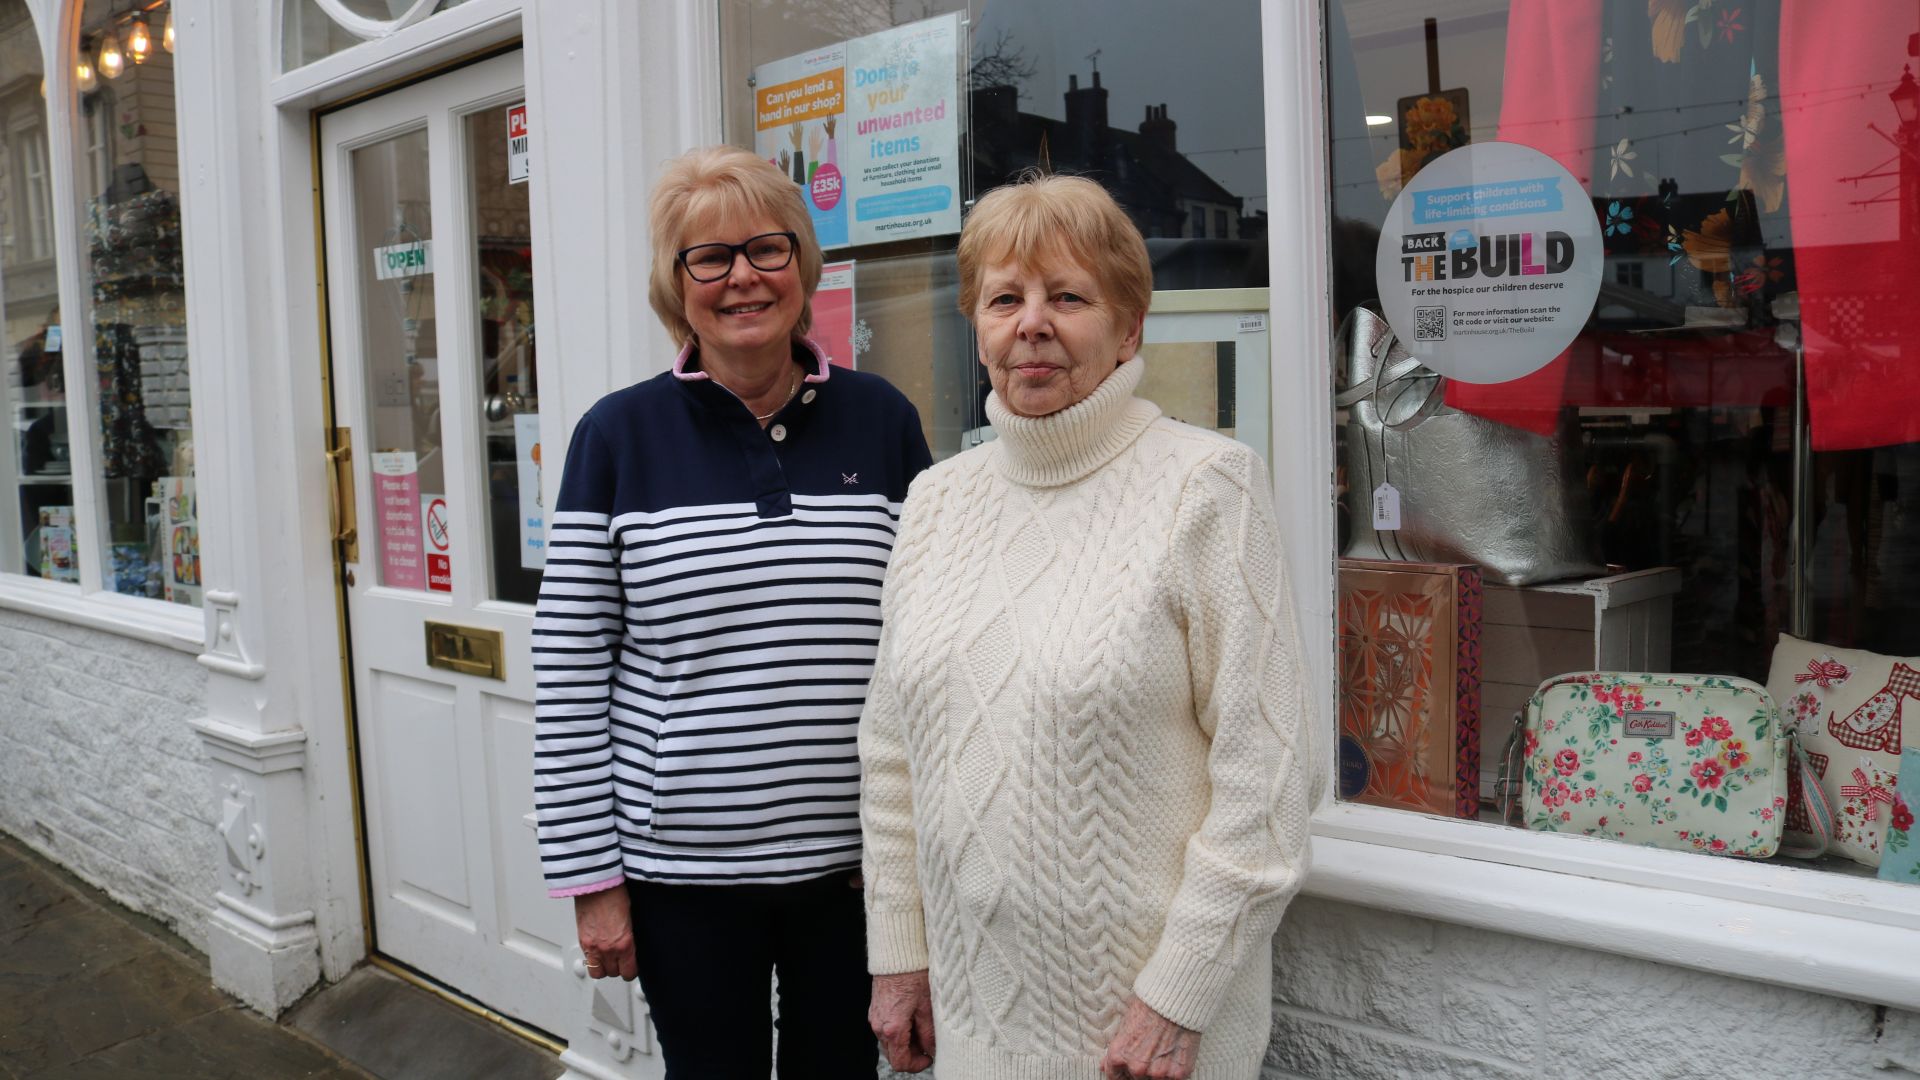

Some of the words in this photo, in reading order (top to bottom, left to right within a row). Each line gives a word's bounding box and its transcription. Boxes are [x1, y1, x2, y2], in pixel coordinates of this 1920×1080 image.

[766, 93, 785, 106] Can
[785, 88, 803, 104] you
[804, 79, 825, 97] lend
[827, 80, 834, 90] a
[867, 84, 909, 112] your
[760, 106, 782, 123] hand
[783, 104, 792, 117] in
[794, 102, 811, 115] our
[812, 92, 841, 110] shop?
[857, 99, 945, 135] unwanted
[870, 136, 920, 159] items
[882, 163, 899, 171] collect
[900, 160, 912, 169] your
[913, 156, 940, 166] donations
[894, 168, 916, 178] clothing
[916, 165, 927, 173] and
[927, 163, 942, 171] small
[813, 176, 840, 193] £35k
[880, 177, 907, 187] household
[1427, 191, 1471, 206] Support
[1473, 185, 1517, 200] children
[1519, 183, 1544, 194] with
[1425, 204, 1488, 220] life-limiting
[1489, 198, 1547, 212] conditions
[875, 218, 932, 231] martinhouse.org.uk
[1407, 236, 1440, 249] BACK
[387, 248, 425, 270] OPEN
[1401, 255, 1446, 282] THE
[1452, 231, 1575, 280] BUILD
[1411, 288, 1425, 296] For
[1427, 287, 1440, 295] the
[1442, 286, 1474, 295] hospice
[1475, 286, 1490, 294] our
[1492, 284, 1527, 292] children
[1529, 282, 1564, 291] deserve
[1486, 307, 1529, 316] information
[1523, 315, 1554, 323] website:
[438, 558, 448, 570] No
